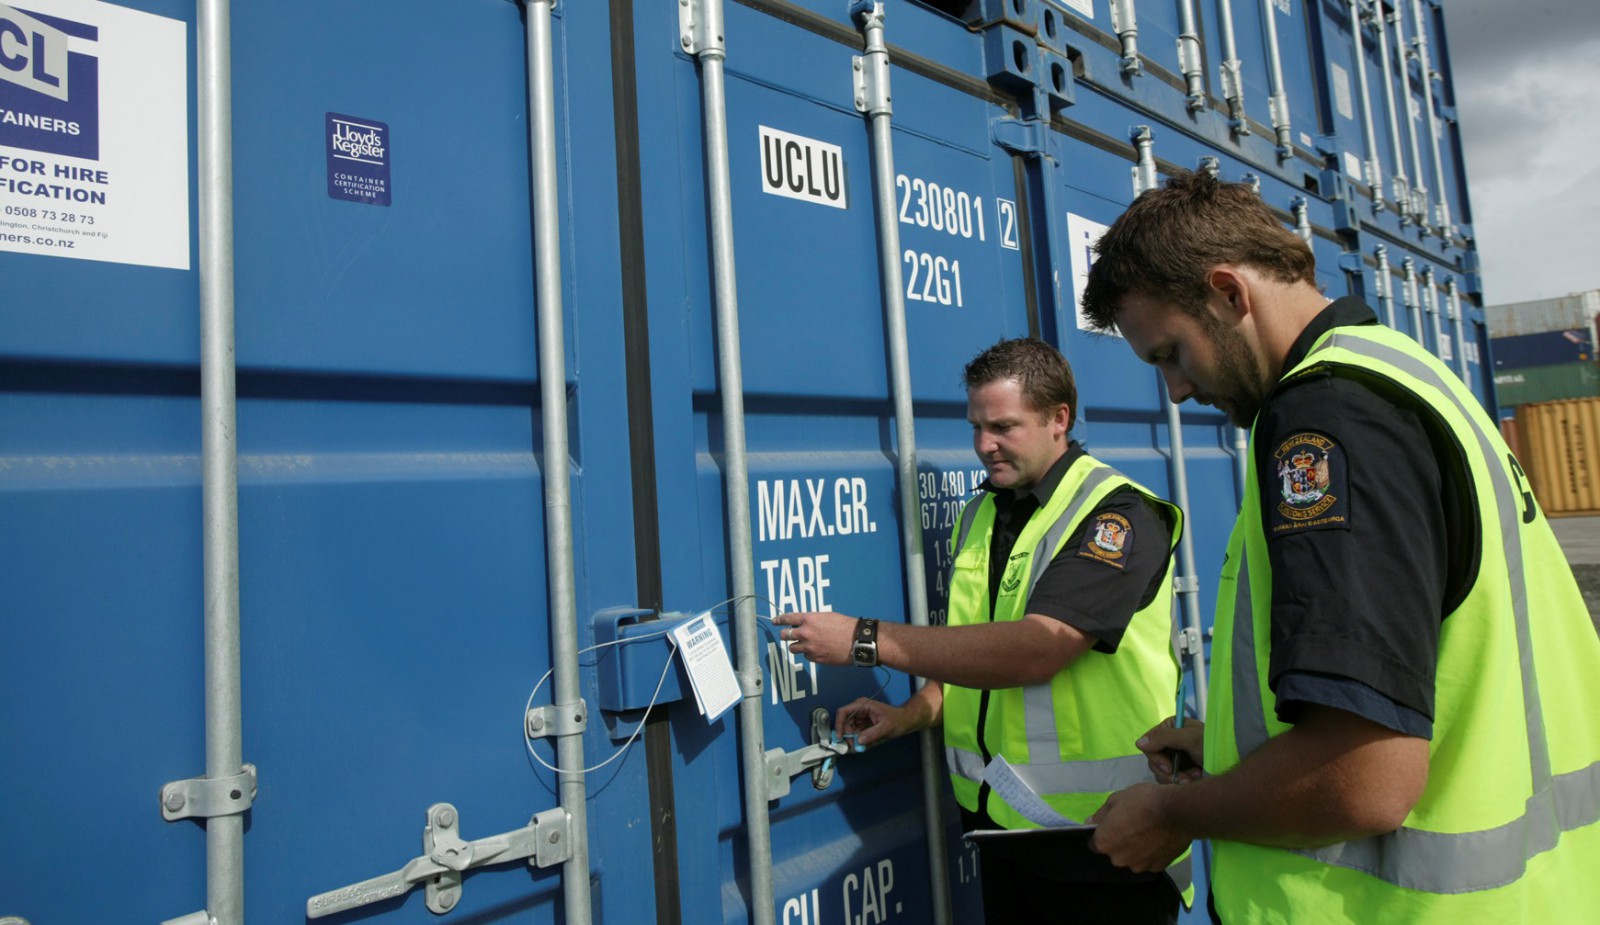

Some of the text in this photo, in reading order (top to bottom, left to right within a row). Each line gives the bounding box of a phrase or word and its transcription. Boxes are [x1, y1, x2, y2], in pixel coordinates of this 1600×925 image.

[332, 134, 385, 157] Register
[337, 123, 381, 147] Lloyd's
[0, 155, 109, 185] FOR HIRE
[334, 173, 385, 186] CONTAINER
[334, 180, 385, 192] CERTIFICATION
[344, 188, 376, 198] SCHEME
[764, 135, 1016, 246] UCLU 230801 2
[5, 205, 94, 225] 0508 73 28 73
[32, 224, 80, 235] Christchurch
[904, 249, 963, 307] 22G1
[1295, 436, 1325, 447] ZEALAND
[757, 477, 877, 541] MAX.GR.
[919, 471, 965, 499] 30,480
[760, 554, 832, 619] TARE
[686, 628, 713, 649] WARNING
[843, 859, 902, 925] CAP.
